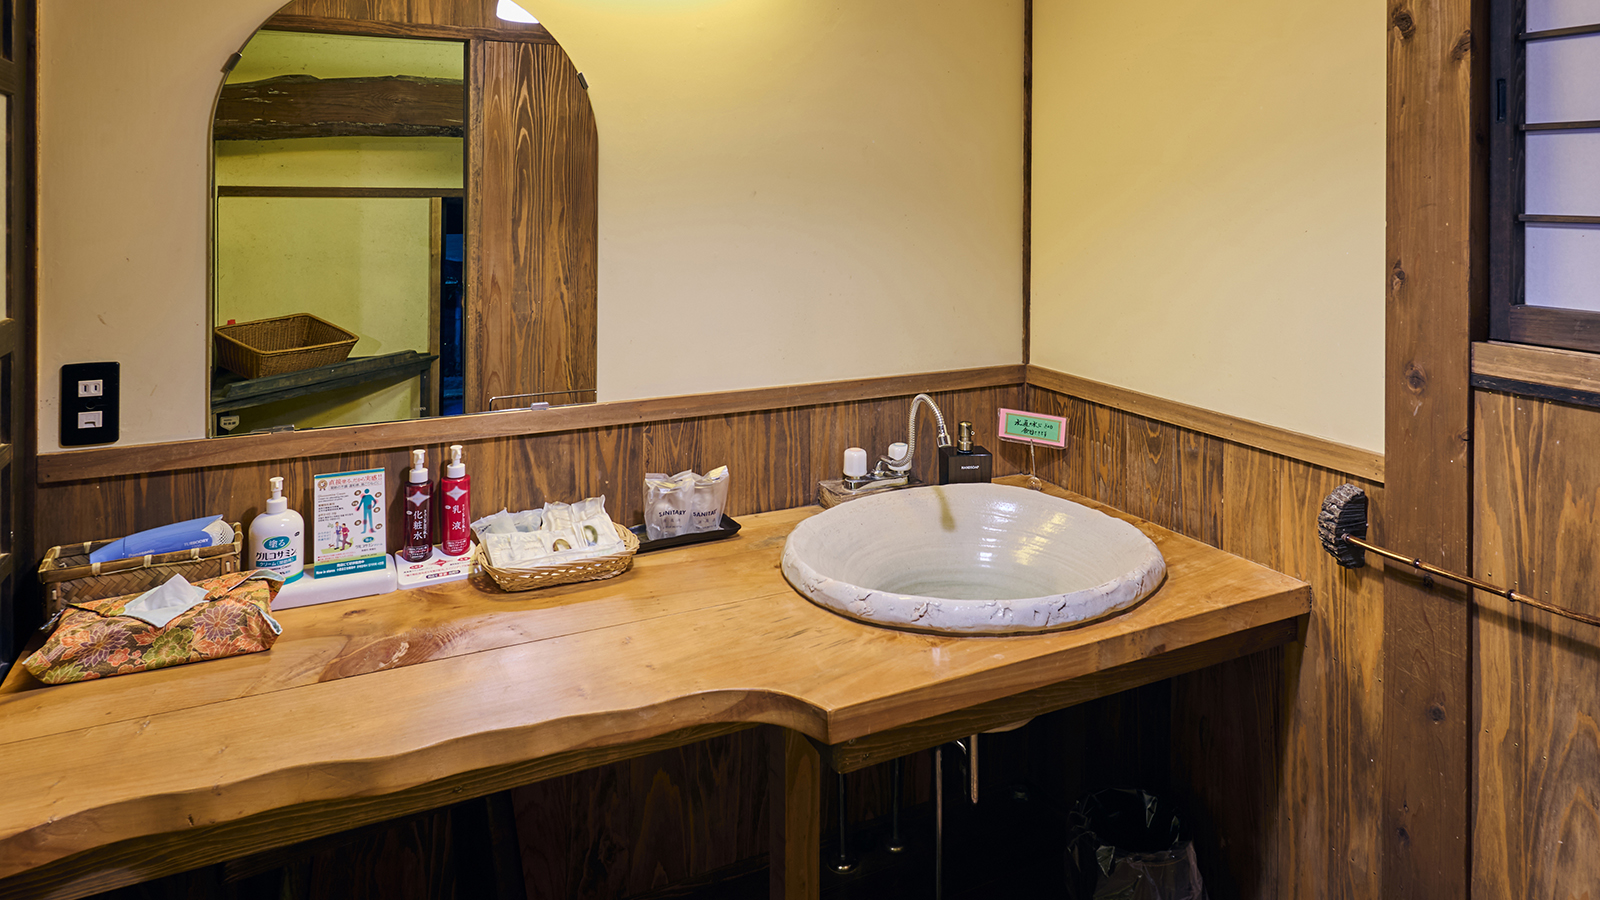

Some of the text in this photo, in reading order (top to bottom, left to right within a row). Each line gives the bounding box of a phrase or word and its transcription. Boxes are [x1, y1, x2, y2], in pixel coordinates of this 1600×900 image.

[413, 510, 423, 540] 化粧水
[452, 505, 462, 530] 乳液
[268, 539, 286, 548] 塗る
[256, 548, 297, 560] グルコサミン
